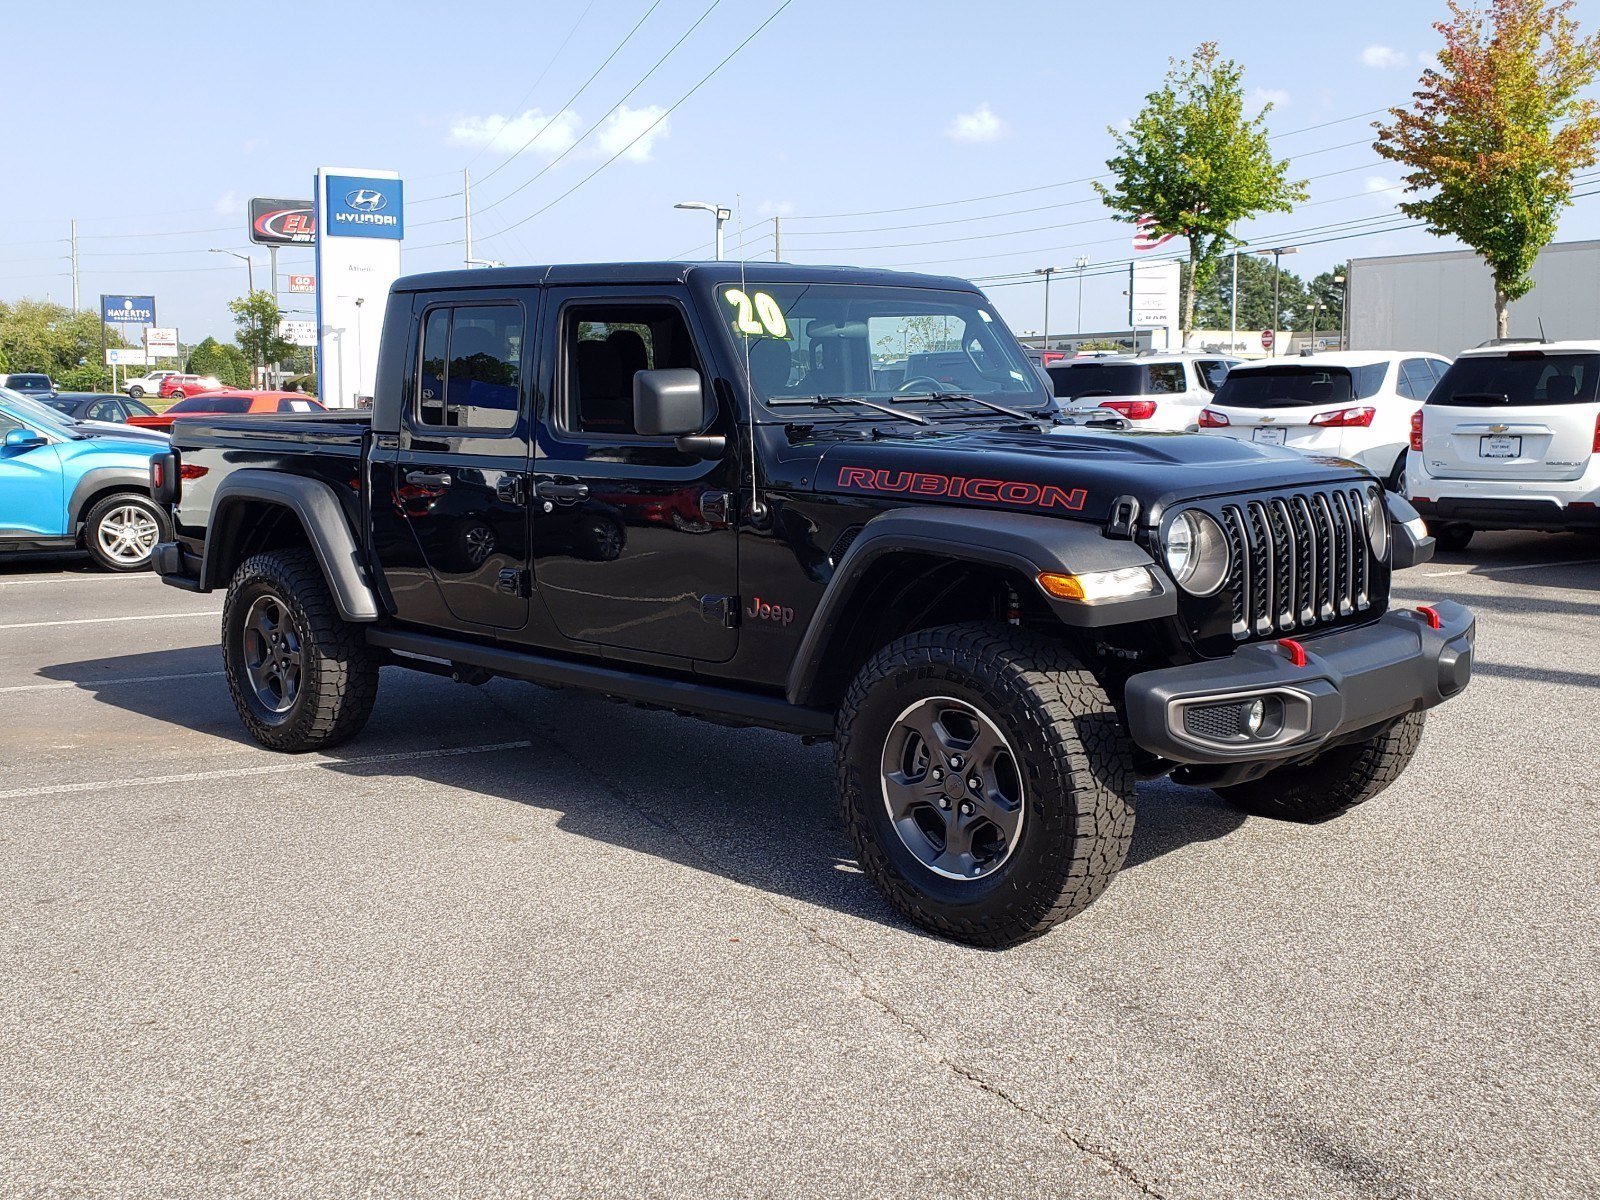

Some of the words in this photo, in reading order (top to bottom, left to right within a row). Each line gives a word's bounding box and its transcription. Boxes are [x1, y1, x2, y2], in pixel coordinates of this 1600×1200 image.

[336, 212, 396, 227] HYUNDAI
[291, 234, 311, 243] AUTO
[295, 276, 311, 285] GO
[107, 309, 151, 318] HAVERTYS
[724, 289, 787, 337] 20
[837, 466, 1088, 511] RUBICON
[746, 597, 795, 627] Jeep
